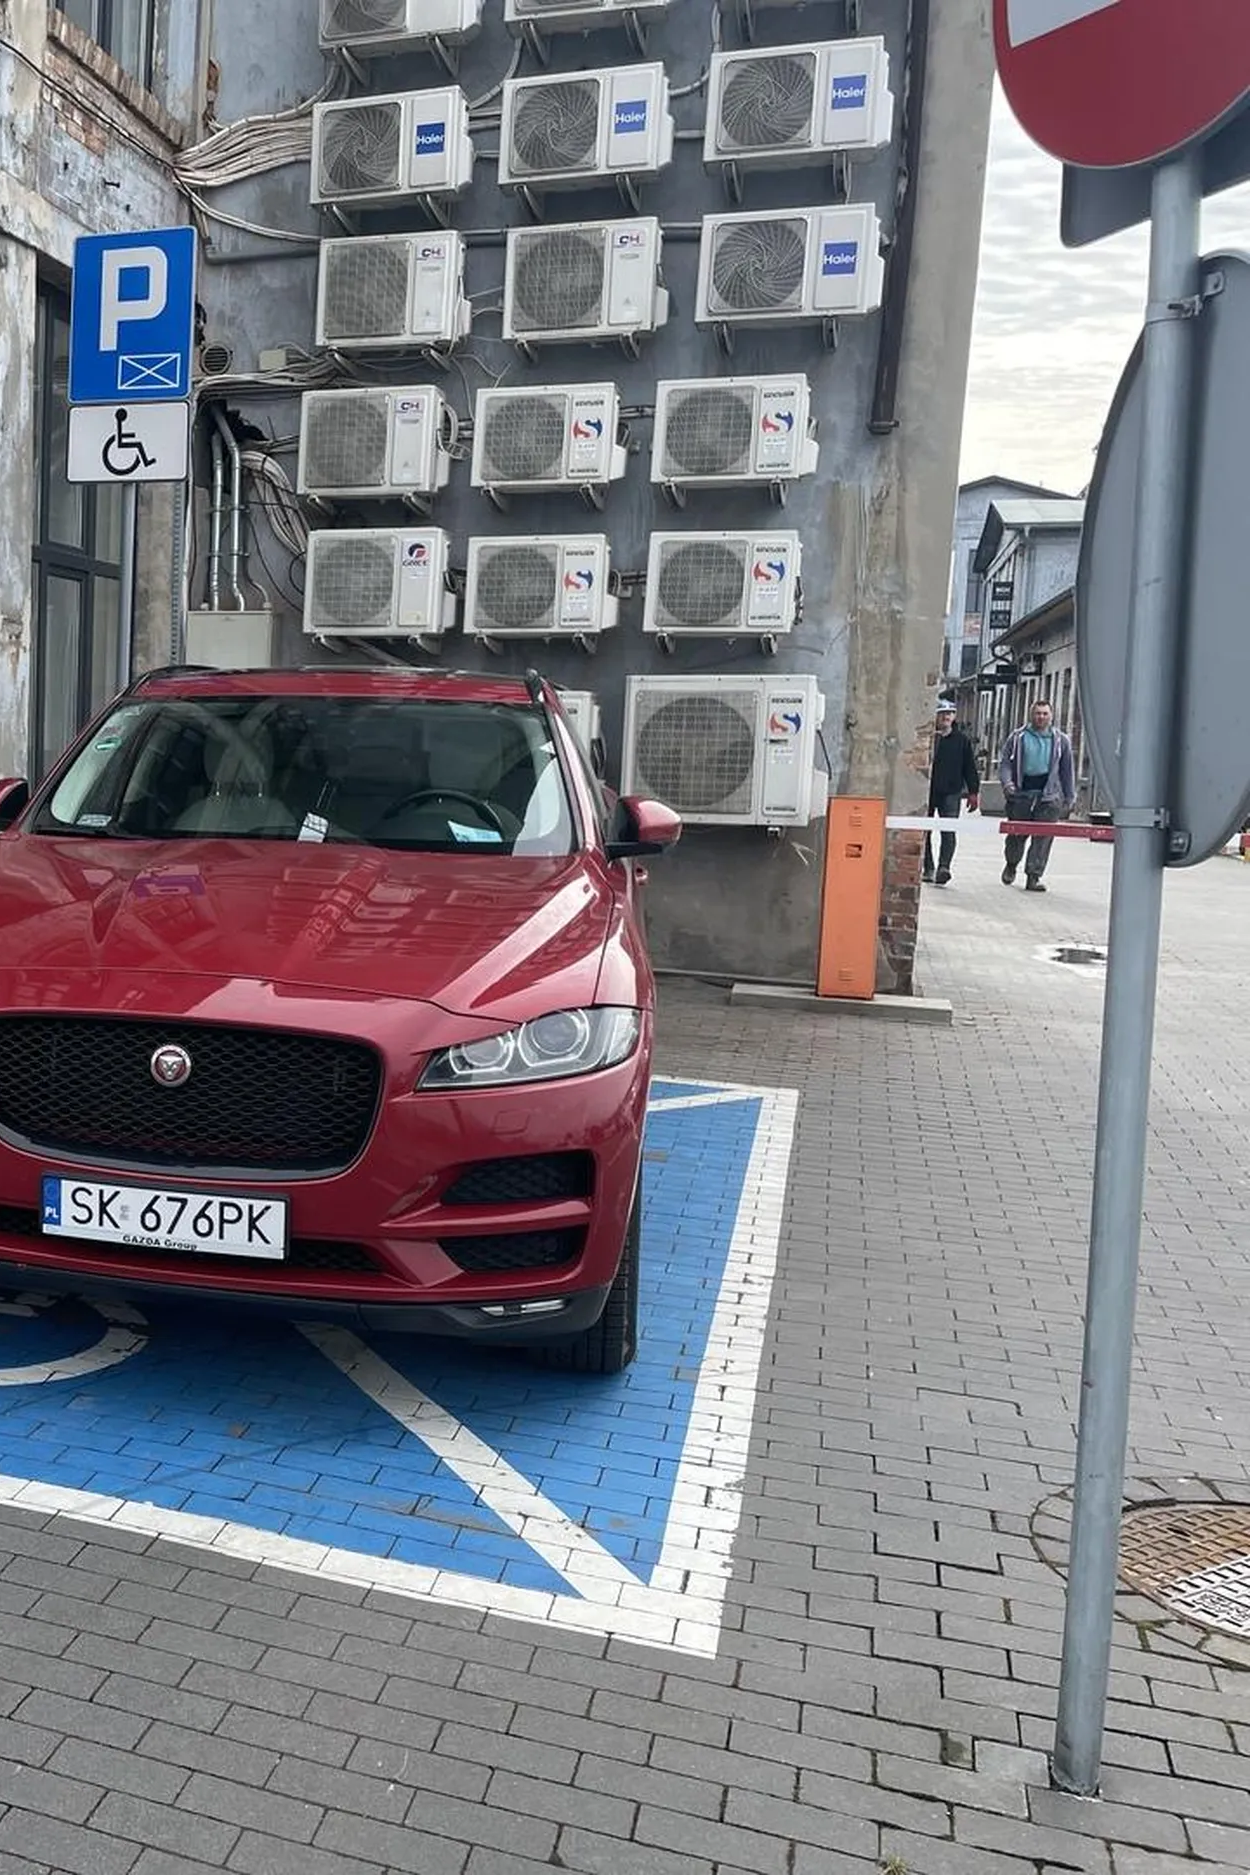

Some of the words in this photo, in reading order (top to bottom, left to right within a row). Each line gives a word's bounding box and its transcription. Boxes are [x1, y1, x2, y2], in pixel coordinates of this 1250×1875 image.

[100, 246, 168, 351] P
[45, 1207, 59, 1219] PL
[71, 1187, 121, 1229] SK
[140, 1195, 272, 1245] 676PK
[164, 1239, 198, 1251] Group
